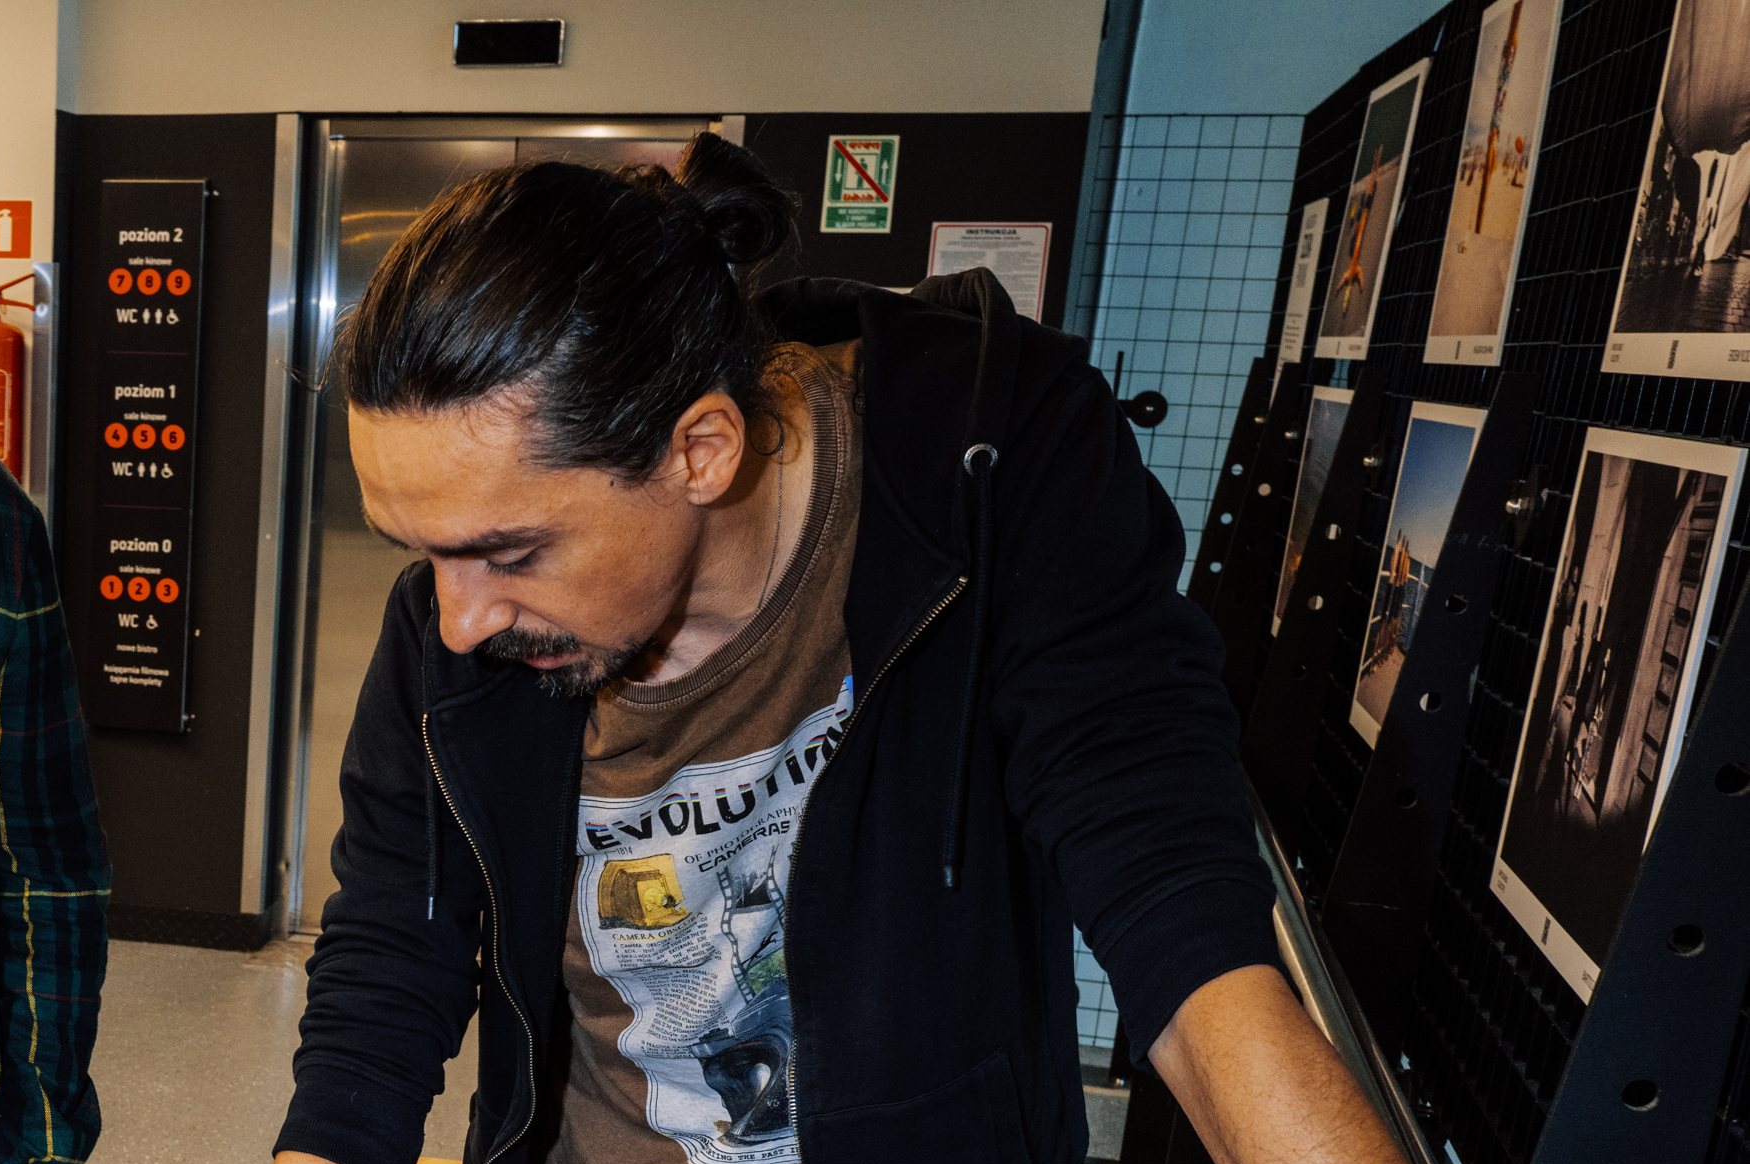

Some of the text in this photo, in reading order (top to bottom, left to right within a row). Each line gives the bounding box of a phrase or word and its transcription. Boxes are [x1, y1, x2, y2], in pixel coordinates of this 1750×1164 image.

[118, 227, 184, 246] poziom 2
[116, 275, 184, 289] 7 8 9
[116, 308, 139, 323] WC
[114, 383, 176, 401] poziom 1
[112, 429, 178, 444] 4 5 6
[112, 462, 134, 477] WC
[109, 537, 172, 554] poziom 0
[119, 564, 135, 574] sale
[135, 582, 143, 595] 2
[163, 584, 172, 597] 3
[118, 613, 139, 628] WC
[136, 643, 159, 654] bistro
[128, 675, 163, 688] komplety
[684, 805, 800, 864] OF PHOTOGRAPHY
[698, 820, 791, 873] CAMERAS
[612, 911, 704, 941] CAMERA OBSCURA
[761, 1148, 785, 1159] PAST
